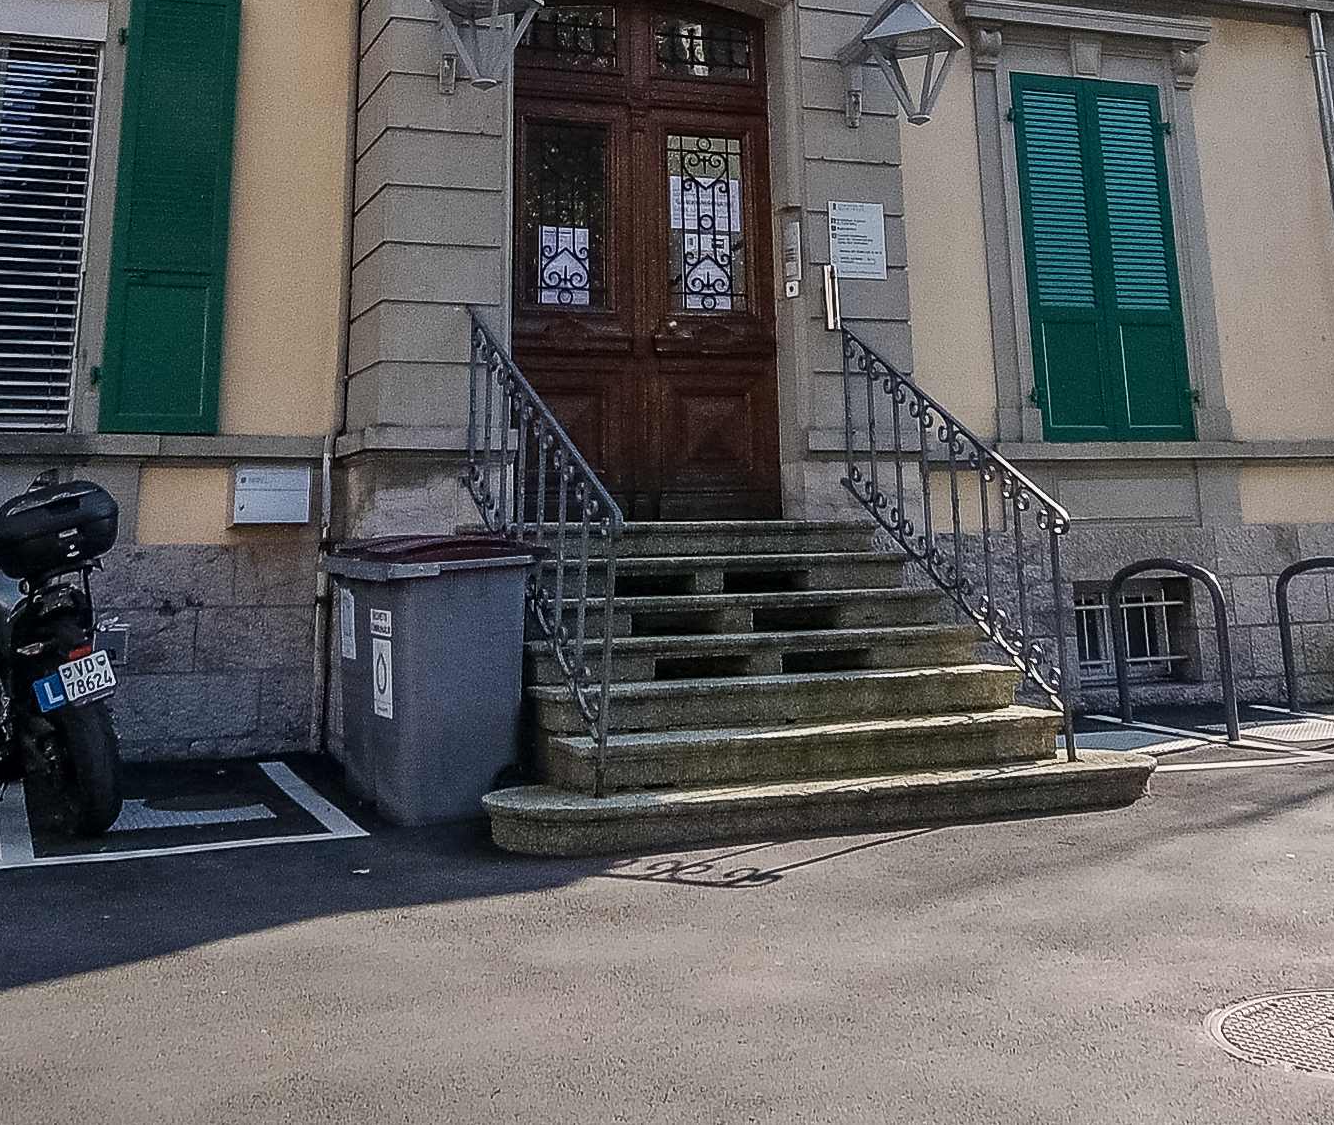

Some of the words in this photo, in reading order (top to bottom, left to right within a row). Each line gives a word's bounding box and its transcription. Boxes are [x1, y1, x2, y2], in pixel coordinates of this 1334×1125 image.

[74, 658, 95, 676] VD
[44, 681, 65, 705] L
[67, 670, 113, 698] 78624
